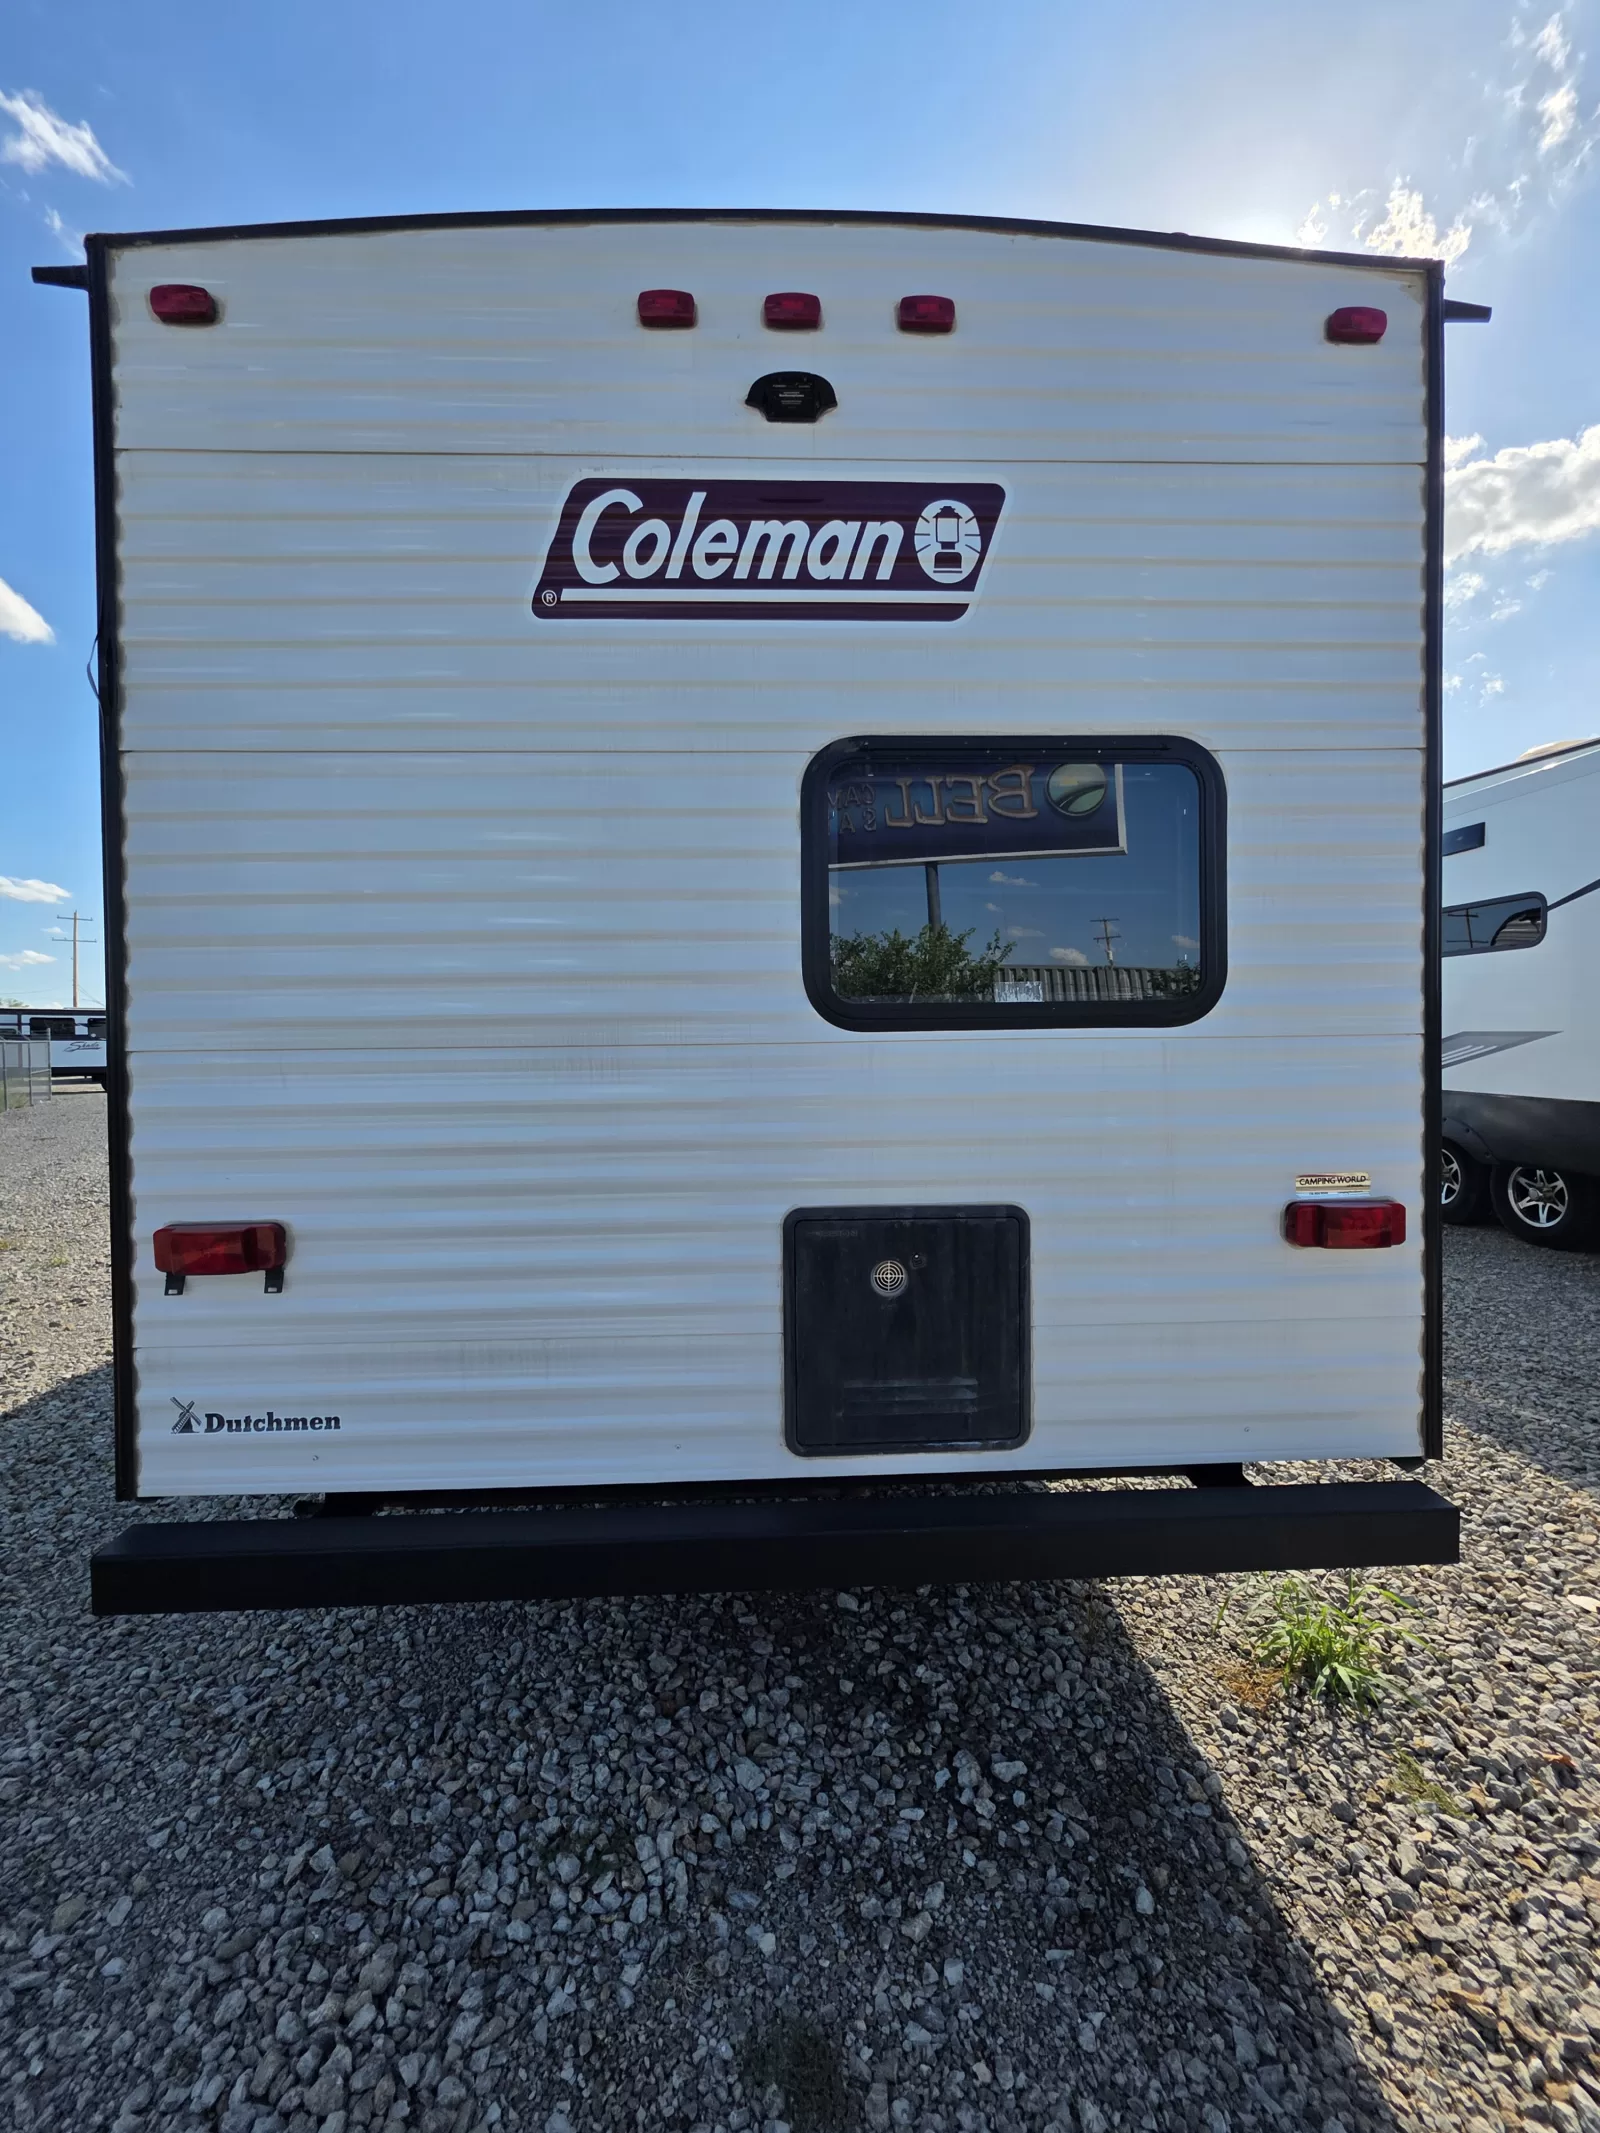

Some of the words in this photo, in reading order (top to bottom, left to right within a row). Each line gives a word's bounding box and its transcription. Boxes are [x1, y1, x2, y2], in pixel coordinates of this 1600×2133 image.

[572, 488, 904, 584] Coleman
[1299, 1177, 1336, 1186] CAMPING
[1336, 1175, 1367, 1184] WORLD
[204, 1411, 341, 1434] Dutchmen
